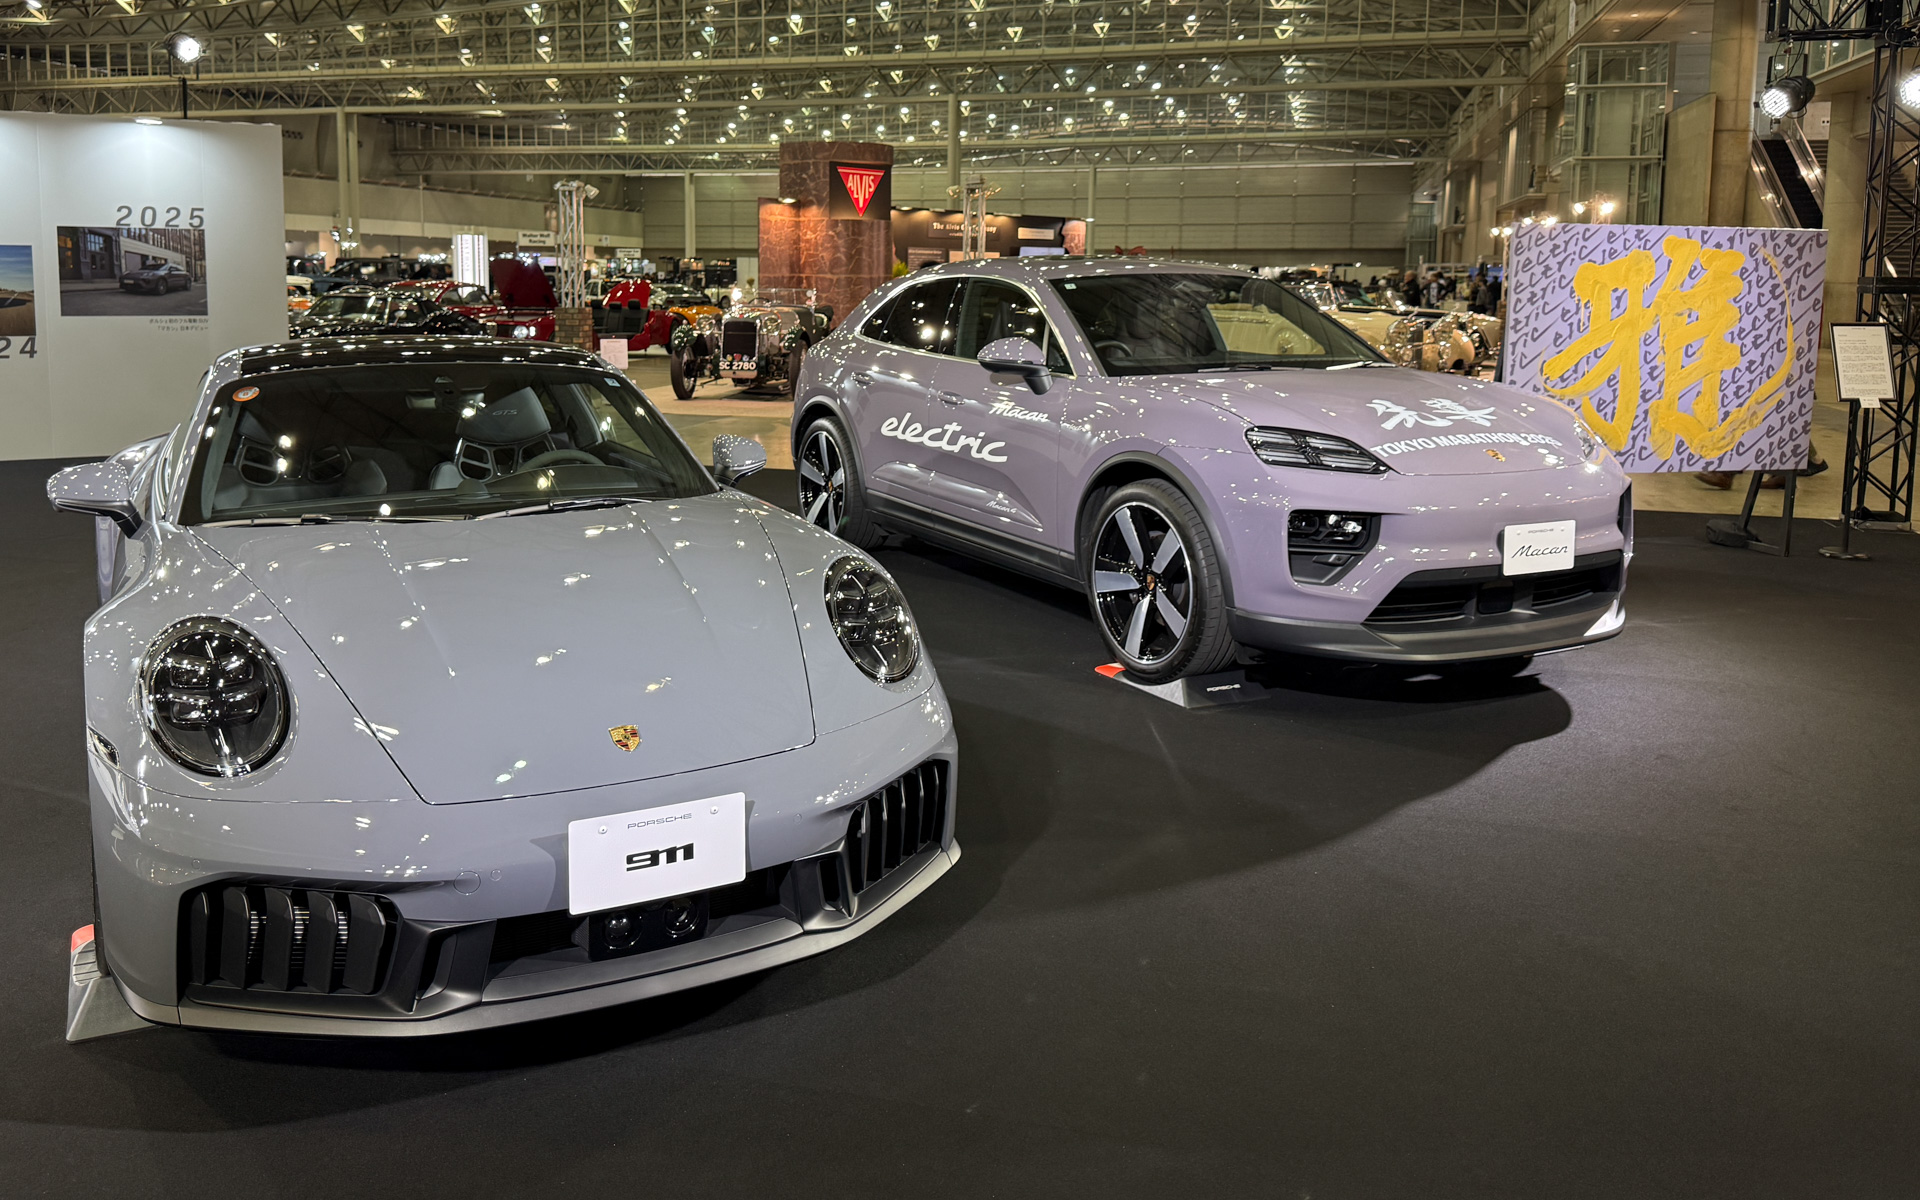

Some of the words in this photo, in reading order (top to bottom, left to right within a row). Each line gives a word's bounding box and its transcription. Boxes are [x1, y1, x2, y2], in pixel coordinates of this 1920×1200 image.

[847, 174, 875, 208] ALVIS
[115, 205, 205, 228] 2025
[719, 362, 731, 370] SC
[732, 362, 756, 370] 2780
[989, 402, 1050, 422] Macan
[880, 412, 1008, 463] electric
[1370, 437, 1437, 458] TOKYO
[1432, 432, 1522, 447] MARATHON
[1511, 545, 1568, 557] Macan
[627, 813, 692, 829] PORSCHE
[626, 842, 694, 872] 911
